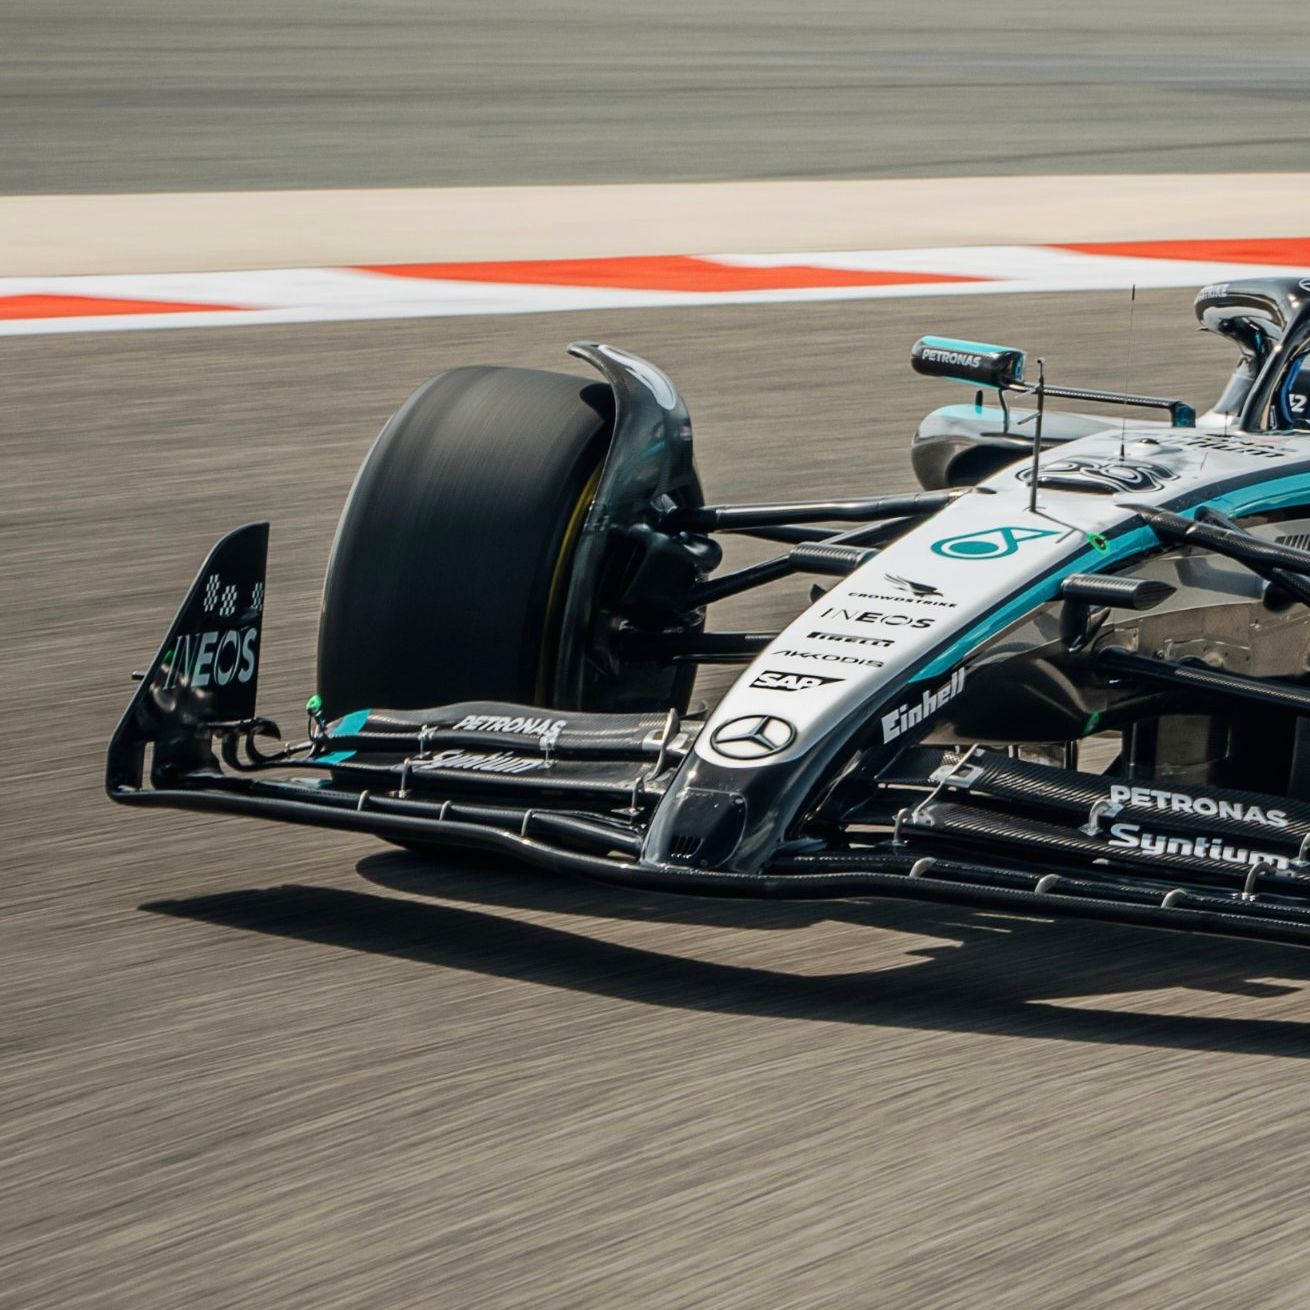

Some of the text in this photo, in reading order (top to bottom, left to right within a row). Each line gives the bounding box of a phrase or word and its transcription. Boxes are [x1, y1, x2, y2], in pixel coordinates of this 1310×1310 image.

[922, 349, 981, 368] PETRONAS
[848, 592, 958, 608] CROWDSTRIKE
[820, 607, 936, 629] INEOS
[806, 631, 895, 647] PIRELLI
[162, 626, 257, 690] INEOS
[771, 650, 885, 667] AKKODIS
[751, 671, 827, 690] SAP
[881, 667, 965, 744] Einhell
[453, 714, 568, 737] PETRONAS
[1110, 784, 1289, 828] PETRONAS
[1108, 823, 1290, 871] Syntium
